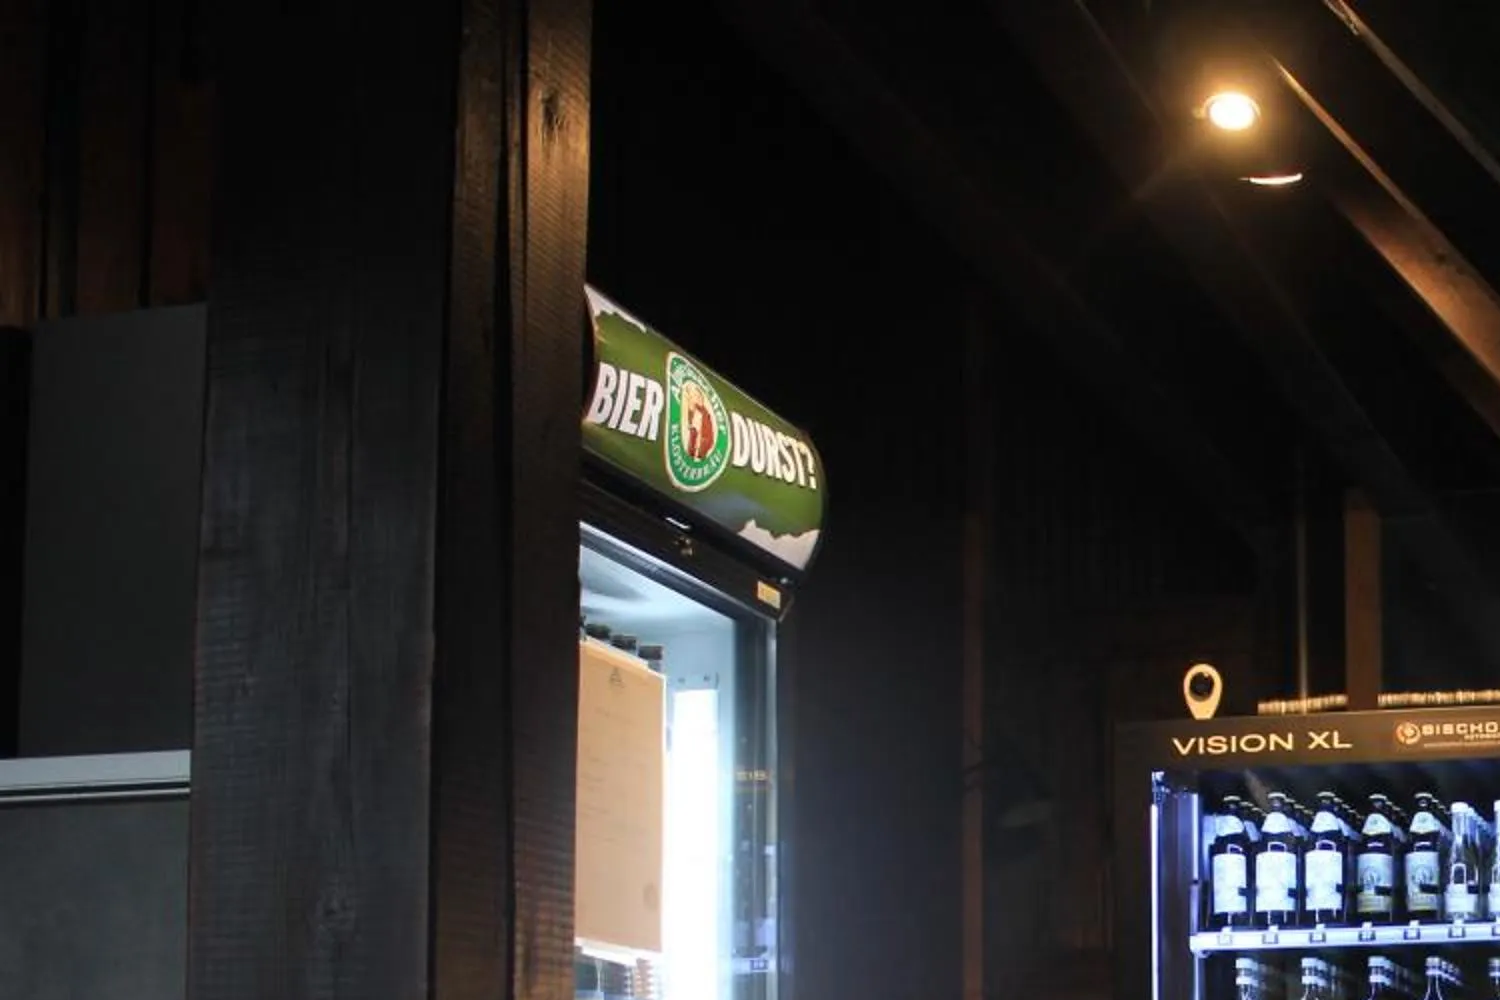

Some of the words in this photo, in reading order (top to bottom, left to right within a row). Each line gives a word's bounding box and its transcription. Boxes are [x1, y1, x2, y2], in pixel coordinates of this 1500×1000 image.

[588, 362, 664, 440] BIER
[1172, 731, 1294, 756] VISION
[1307, 730, 1353, 750] XL
